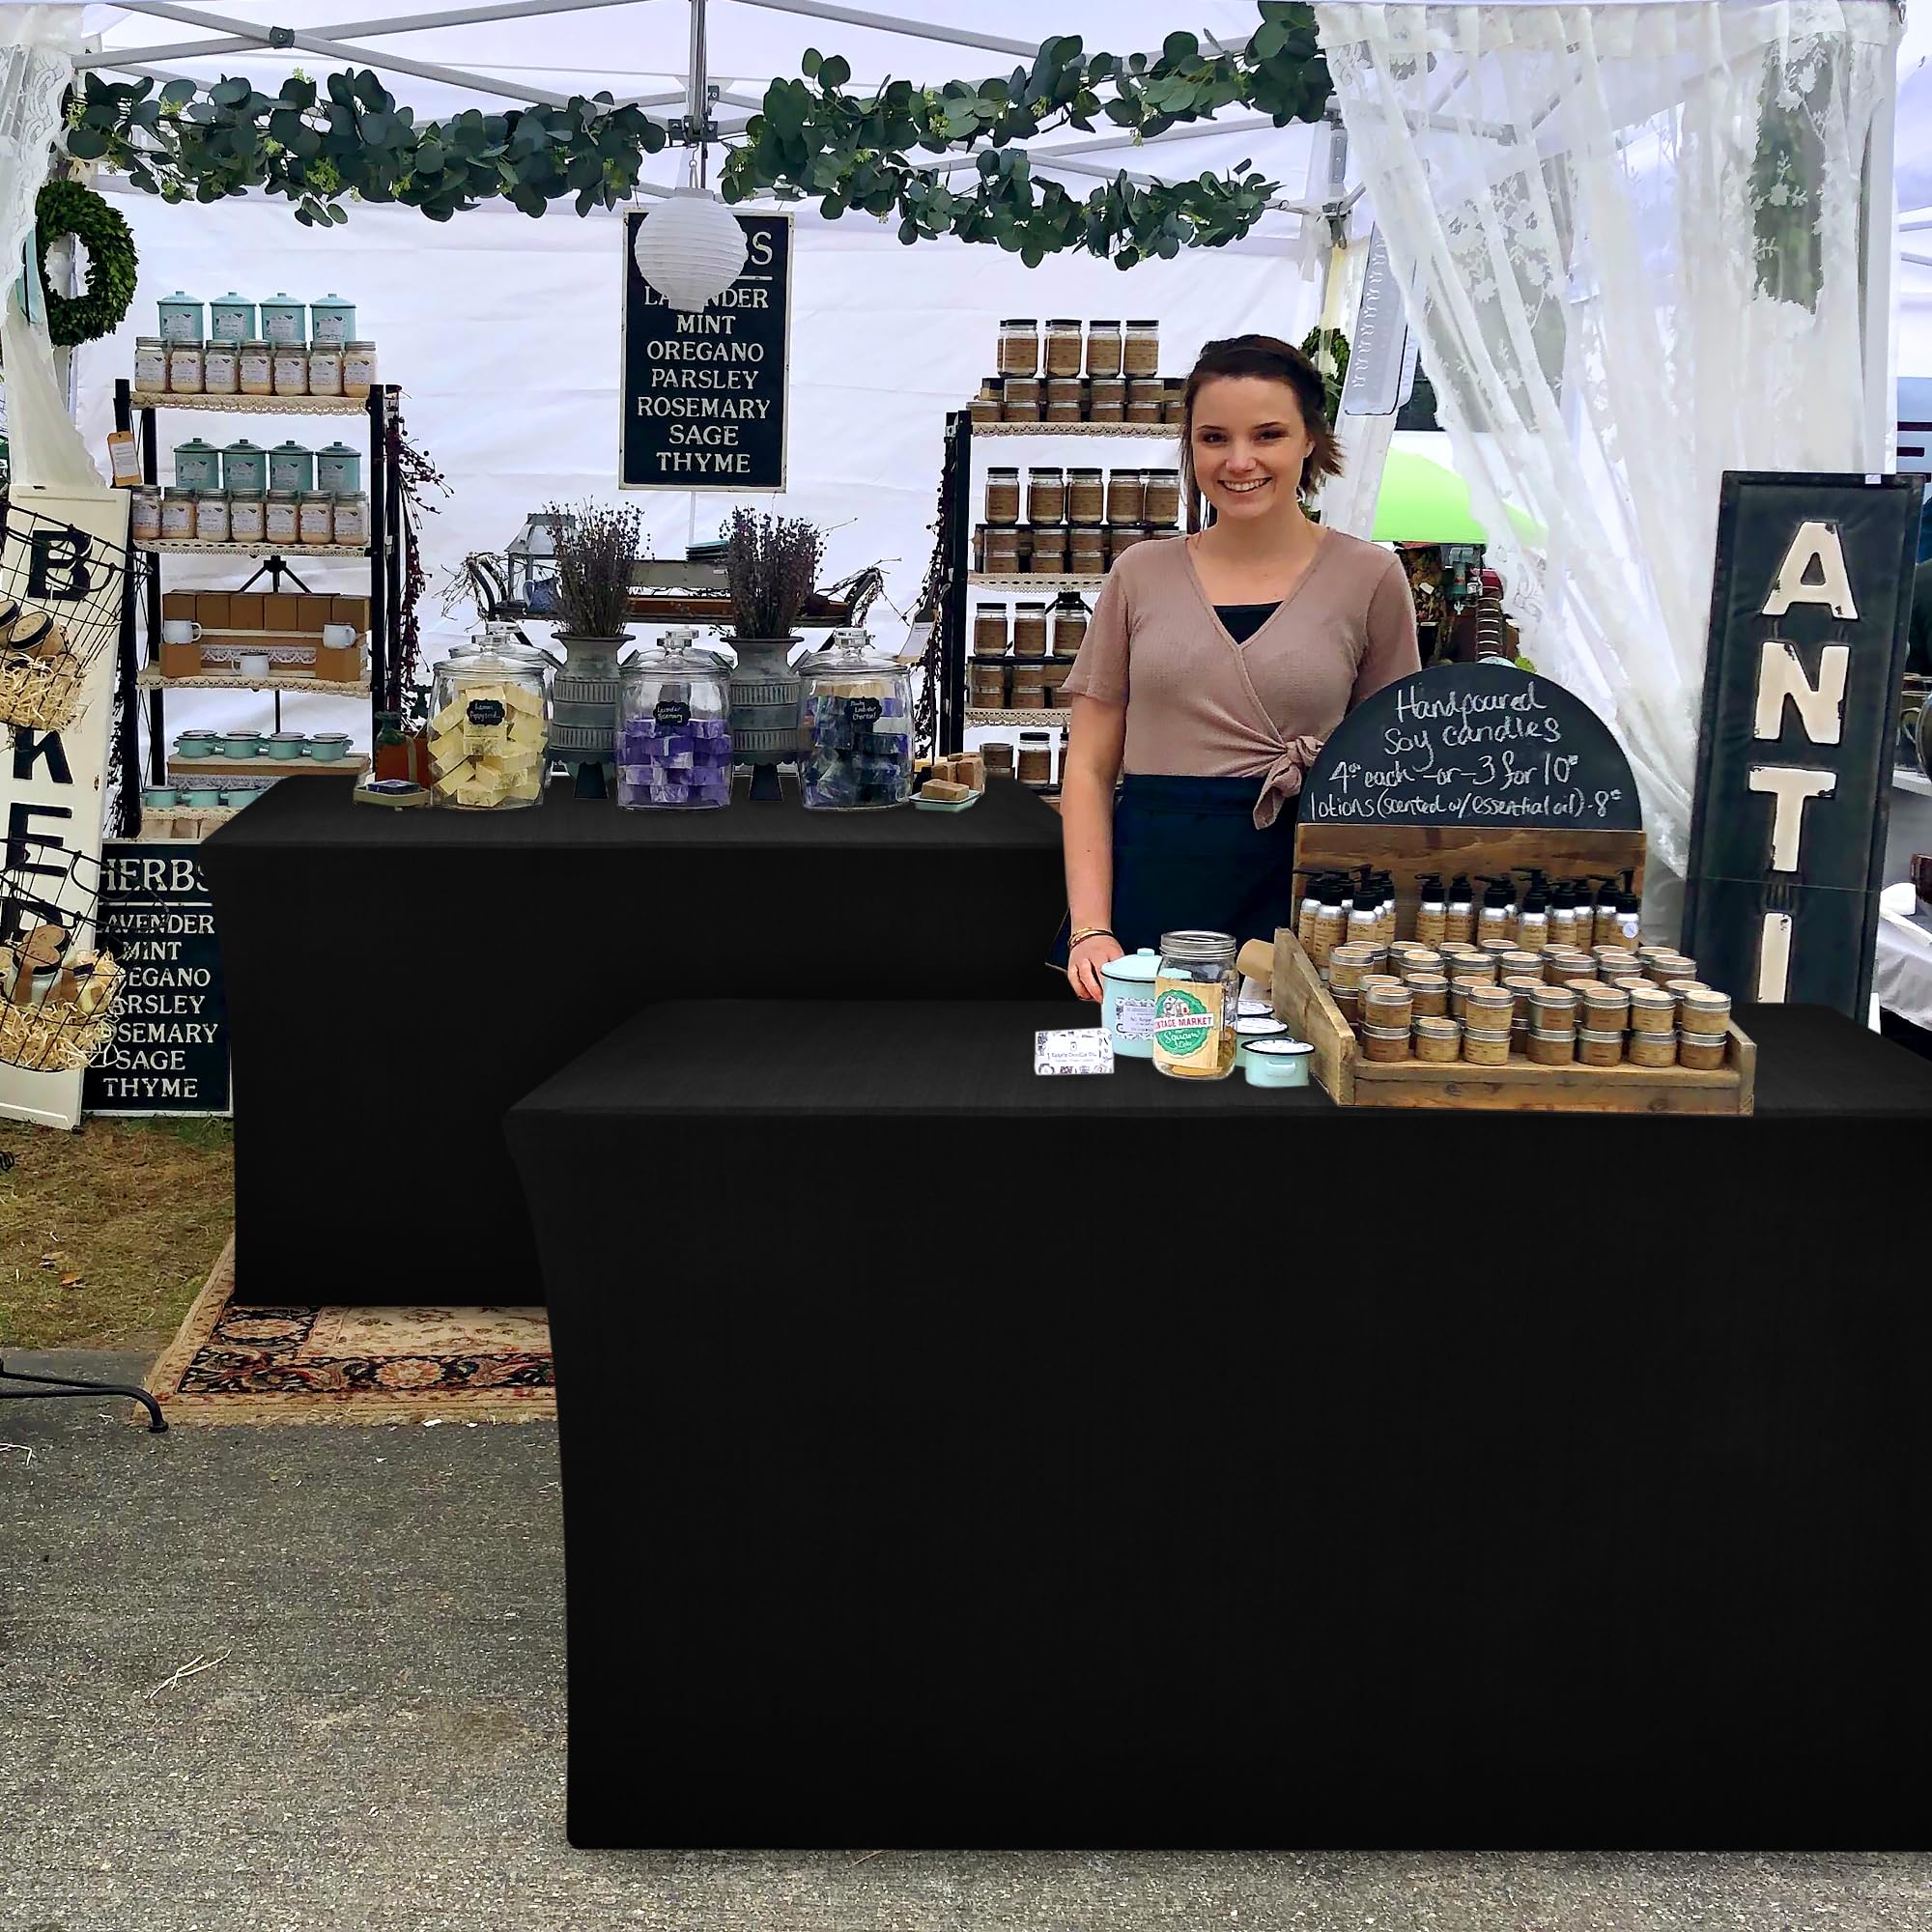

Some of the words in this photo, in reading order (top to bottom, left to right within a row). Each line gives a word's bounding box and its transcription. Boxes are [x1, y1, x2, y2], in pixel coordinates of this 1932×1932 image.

[676, 315, 736, 335] MINT
[646, 340, 764, 362] OREGANO
[651, 368, 759, 389] PARSLEY
[637, 396, 770, 419] ROSEMARY
[668, 425, 739, 446] SAGE
[656, 452, 751, 473] THYME
[1383, 727, 1435, 773] Soy
[1442, 715, 1562, 747] candles
[1364, 761, 1415, 787] each
[1499, 750, 1538, 791] for
[127, 968, 212, 987] EGANO
[109, 995, 206, 1014] ARSLEY
[1178, 1016, 1212, 1027] MARKET
[114, 1023, 218, 1044] SEMARY
[115, 1050, 186, 1070] SAGE
[102, 1077, 199, 1098] THYME
